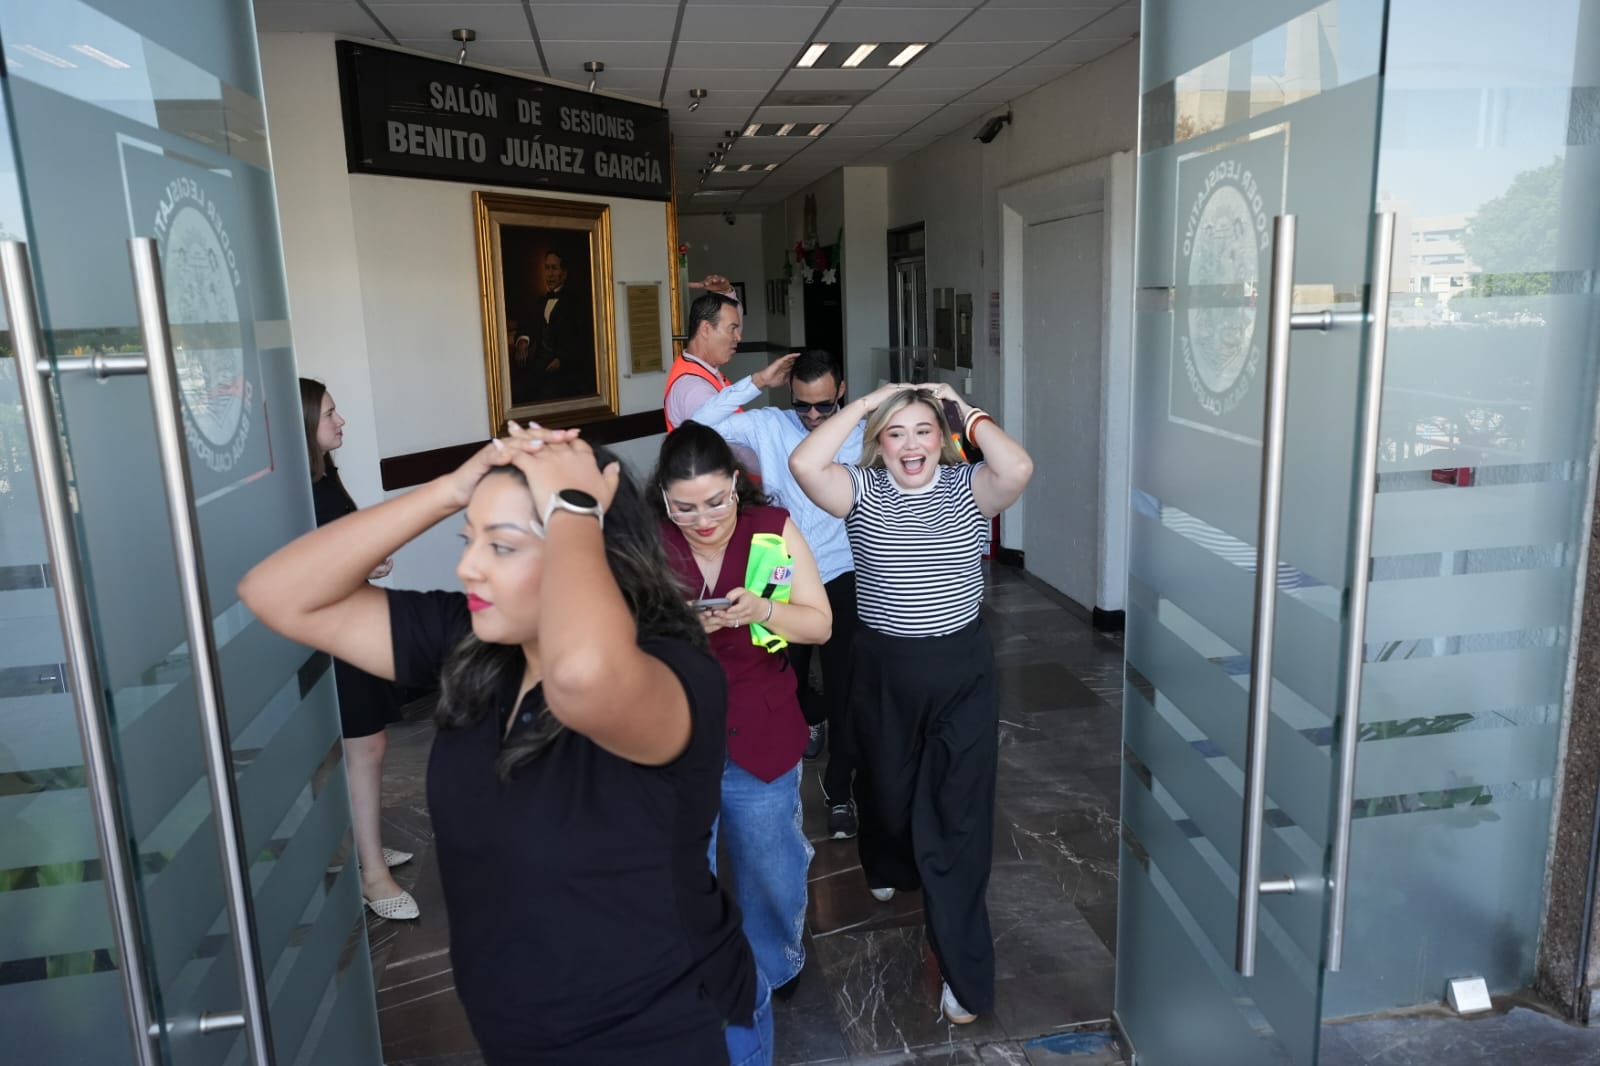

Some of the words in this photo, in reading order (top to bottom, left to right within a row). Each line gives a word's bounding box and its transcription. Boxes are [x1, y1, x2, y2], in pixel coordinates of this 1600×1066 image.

[429, 81, 498, 119] SALÓN
[517, 98, 542, 126] DE
[560, 105, 635, 142] SESIONES
[386, 120, 486, 164] BENITO
[500, 134, 586, 174] JUÁREZ
[594, 150, 663, 185] GARCÍA
